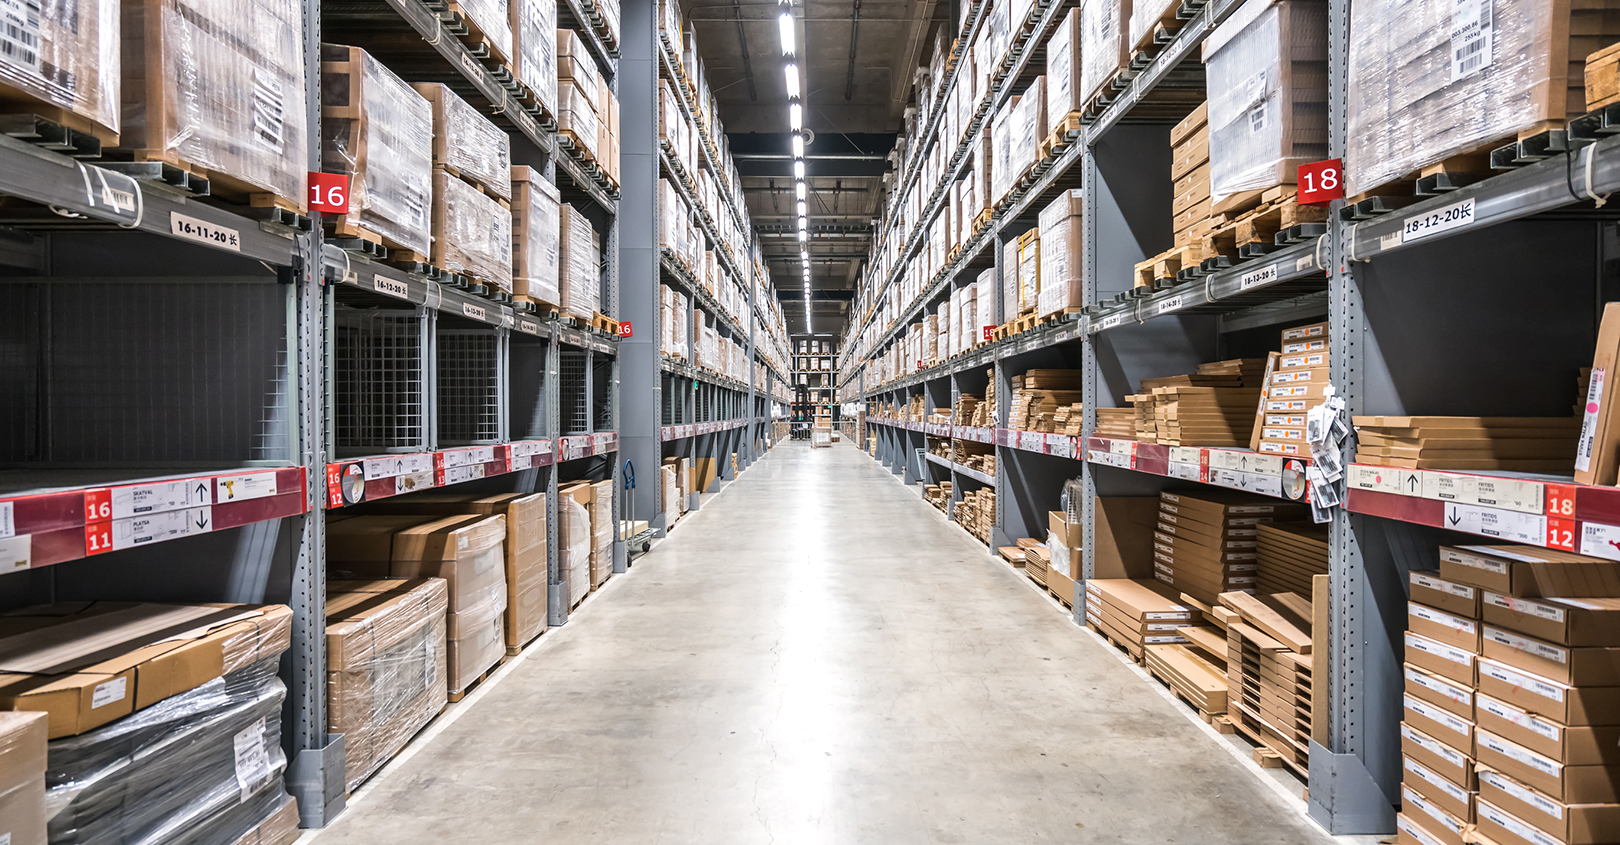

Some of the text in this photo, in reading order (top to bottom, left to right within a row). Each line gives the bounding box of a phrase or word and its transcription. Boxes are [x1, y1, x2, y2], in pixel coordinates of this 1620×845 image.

[1303, 168, 1338, 194] 18
[311, 184, 345, 206] 16
[178, 221, 227, 243] 16-11-20
[377, 280, 401, 293] 16-12-20
[1244, 271, 1269, 285] 18-13-20
[619, 325, 631, 334] 16
[437, 459, 445, 468] 16
[329, 473, 340, 484] 16
[332, 493, 343, 505] 12
[1549, 497, 1573, 515] 18
[88, 501, 110, 519] 16
[89, 532, 111, 550] 11
[1549, 529, 1573, 548] 12
